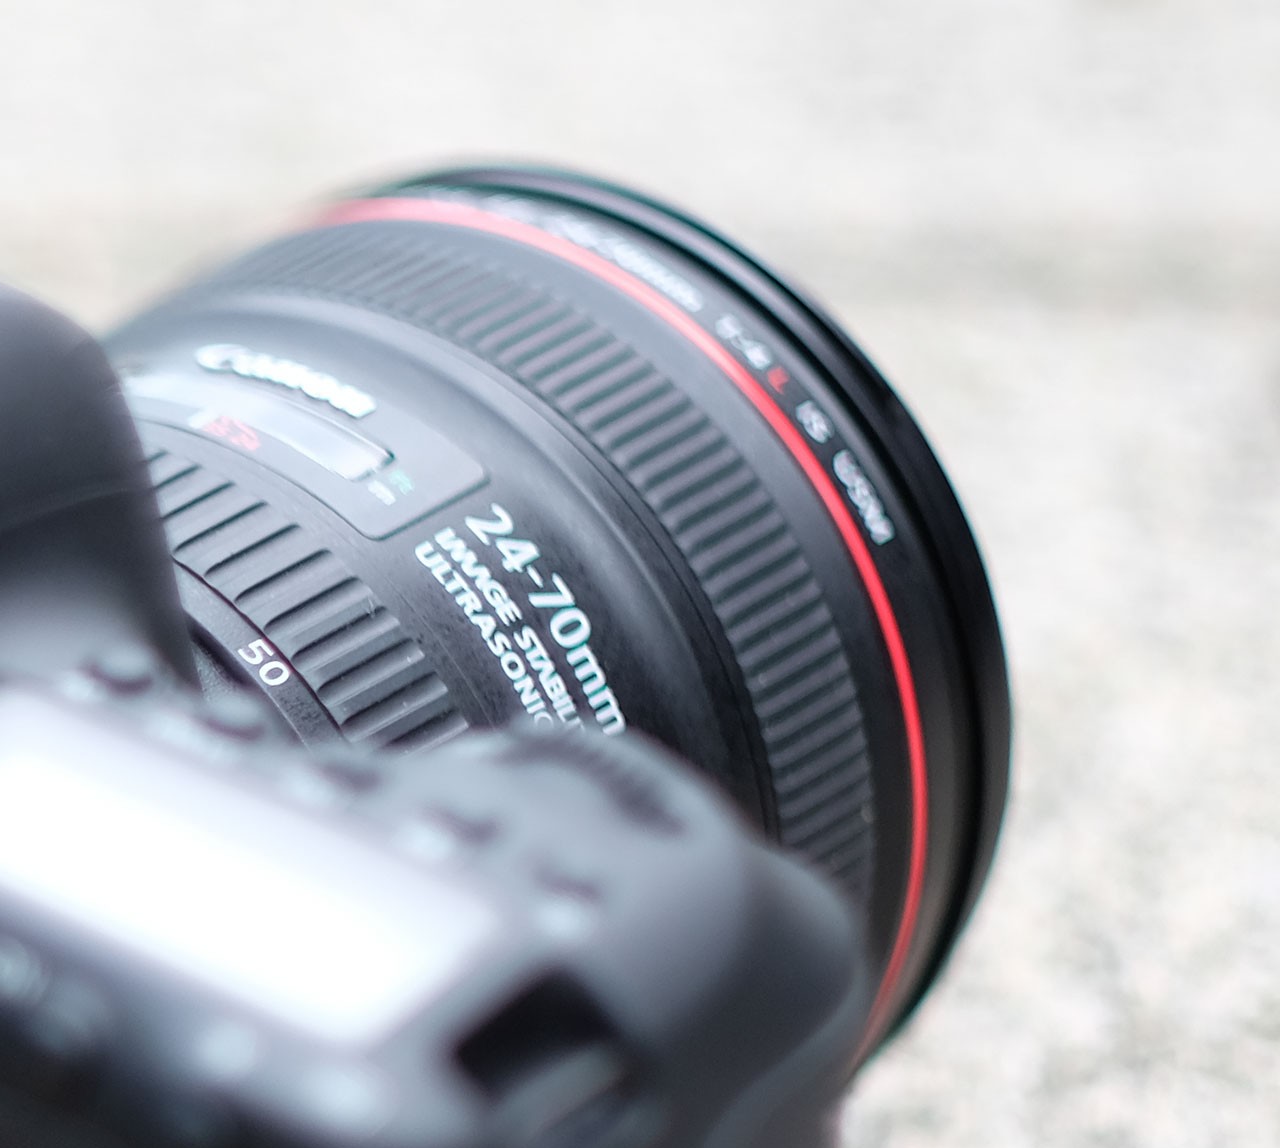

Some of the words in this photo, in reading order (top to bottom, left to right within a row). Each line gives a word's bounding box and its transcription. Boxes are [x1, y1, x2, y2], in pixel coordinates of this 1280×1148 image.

[434, 527, 523, 627] IMAGE
[465, 503, 626, 736] 24-70mm
[238, 638, 290, 686] 50
